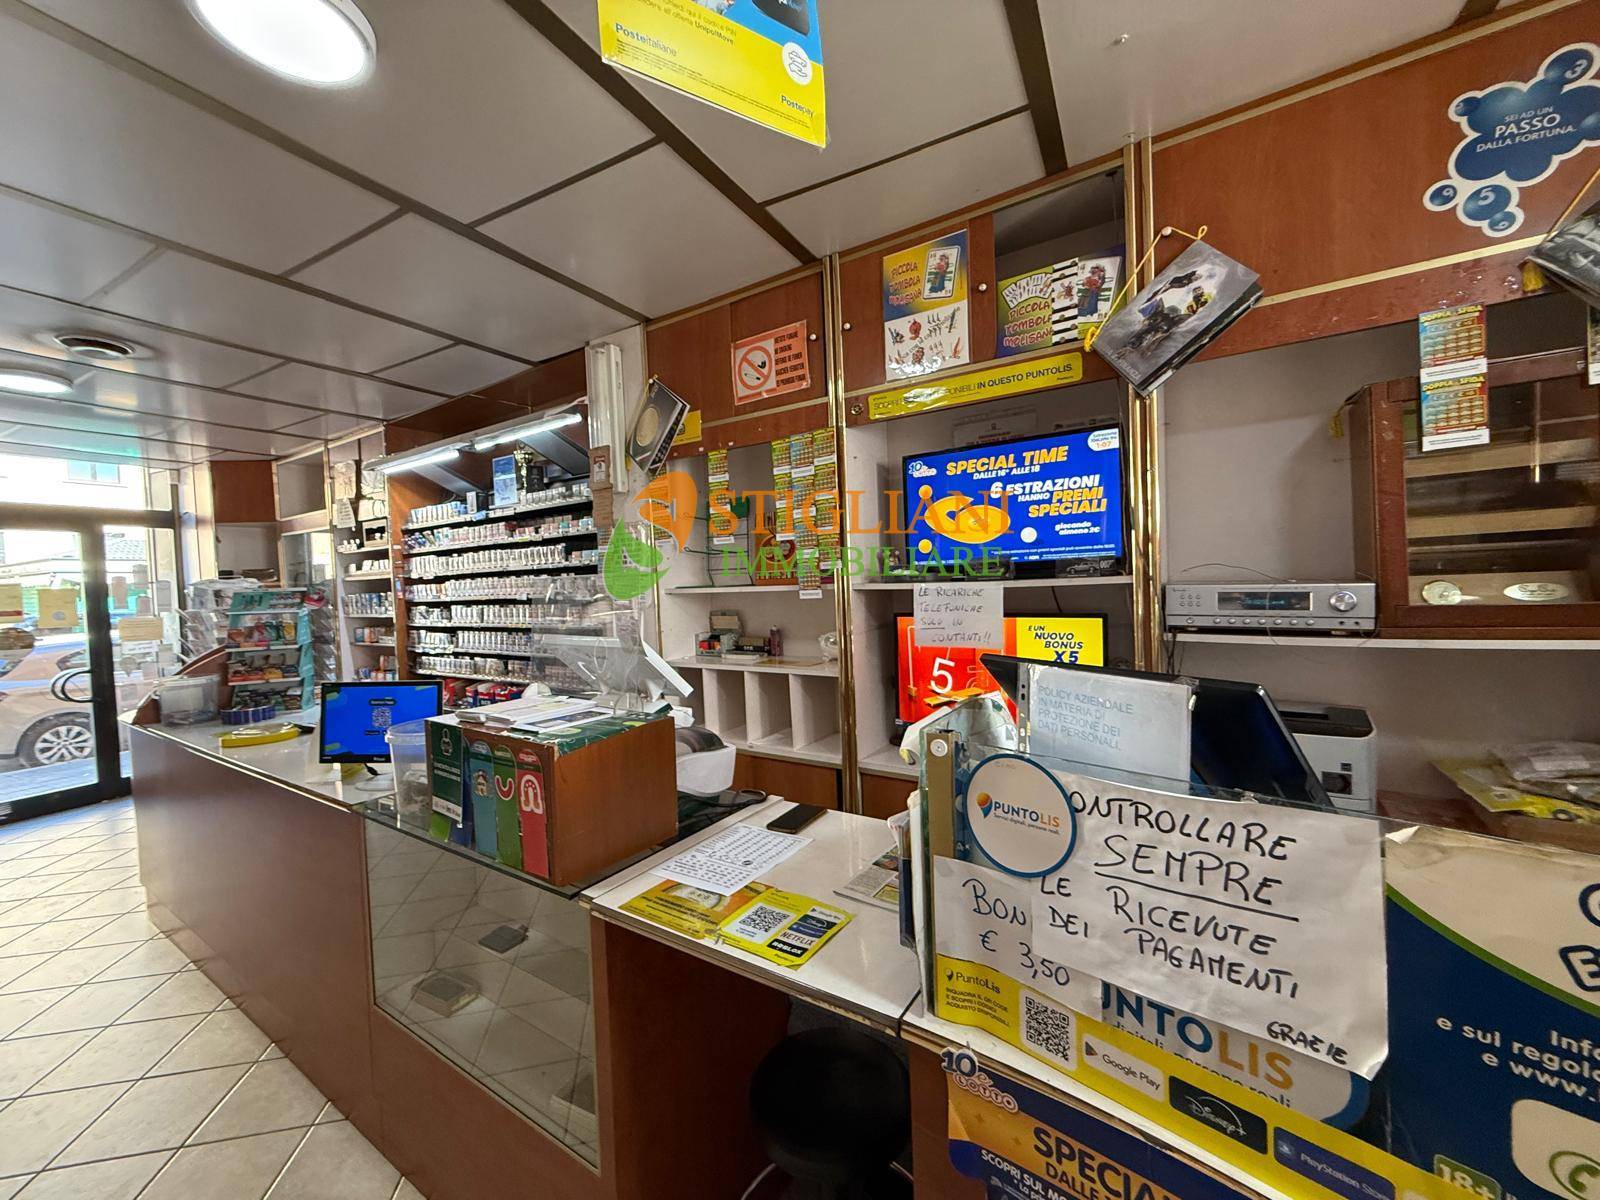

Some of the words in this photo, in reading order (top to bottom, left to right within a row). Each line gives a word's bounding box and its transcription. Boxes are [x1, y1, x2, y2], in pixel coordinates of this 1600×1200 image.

[615, 22, 677, 57] Posteitaliane
[1564, 59, 1588, 79] 3
[781, 95, 815, 118] Postepay
[1520, 110, 1535, 121] AD
[1537, 106, 1553, 117] UN
[1494, 113, 1561, 138] PASSO
[1476, 134, 1512, 152] DALLA
[1515, 125, 1576, 144] FORTUNA
[1478, 187, 1496, 206] 5
[891, 262, 918, 279] PICCOLA
[1009, 301, 1050, 320] PICCOLA
[977, 381, 985, 389] IN
[987, 373, 1024, 387] QUESTO
[1026, 364, 1073, 381] PUNTOLIS
[946, 454, 1016, 475] SPECIAL
[1023, 446, 1068, 464] TIME
[973, 471, 997, 479] DALLE
[1011, 466, 1030, 475] ALLE
[990, 482, 1003, 498] 6
[1006, 474, 1100, 495] ESTRAZIONI
[1018, 492, 1050, 502] HANNO
[1052, 486, 1104, 502] PREMI
[1028, 498, 1107, 518] SPECIALI
[1055, 521, 1092, 531] giocando
[918, 586, 929, 598] LE
[936, 586, 985, 598] RICARICHE
[918, 602, 984, 613] TELEFONICHE
[920, 617, 944, 627] SOLO
[952, 618, 963, 627] IN
[1034, 632, 1075, 640] NUOVO
[1044, 641, 1084, 650] BONUS
[930, 656, 956, 695] 5
[1039, 685, 1071, 700] POLICY
[1075, 693, 1134, 714] AZIENDALE
[1048, 700, 1092, 717] MATERIA
[1095, 710, 1105, 720] DI
[1038, 709, 1099, 732] PROTEZIONE
[1102, 725, 1120, 737] DEI
[1038, 720, 1058, 734] DATI
[994, 801, 1060, 828] PUNTOLIS
[1069, 790, 1297, 861] ONTROLLARE
[1095, 834, 1284, 906] SEMPRE
[1041, 875, 1073, 897] LE
[1107, 886, 1277, 956] RICEVUTE
[771, 941, 803, 955] ROBLOX
[781, 931, 816, 946] NETFLIX
[979, 929, 999, 952] €
[1018, 940, 1070, 988] 3,50
[1049, 905, 1088, 939] DEI
[1124, 927, 1298, 999] PAGAMENTI
[956, 972, 1001, 994] PuntoLis
[1266, 1021, 1348, 1066] GRAZIE
[1436, 1017, 1452, 1031] e
[1462, 1025, 1500, 1048] sul
[941, 1047, 978, 1077] 10
[1103, 1053, 1137, 1077] Google
[1139, 1071, 1161, 1091] Play
[1481, 1053, 1499, 1067] e
[1508, 1060, 1600, 1104] www.
[954, 1072, 1018, 1113] LOTTO
[980, 1149, 1020, 1180] SCOPRI
[1023, 1172, 1046, 1195] SUL
[1301, 1152, 1360, 1190] PlayStation
